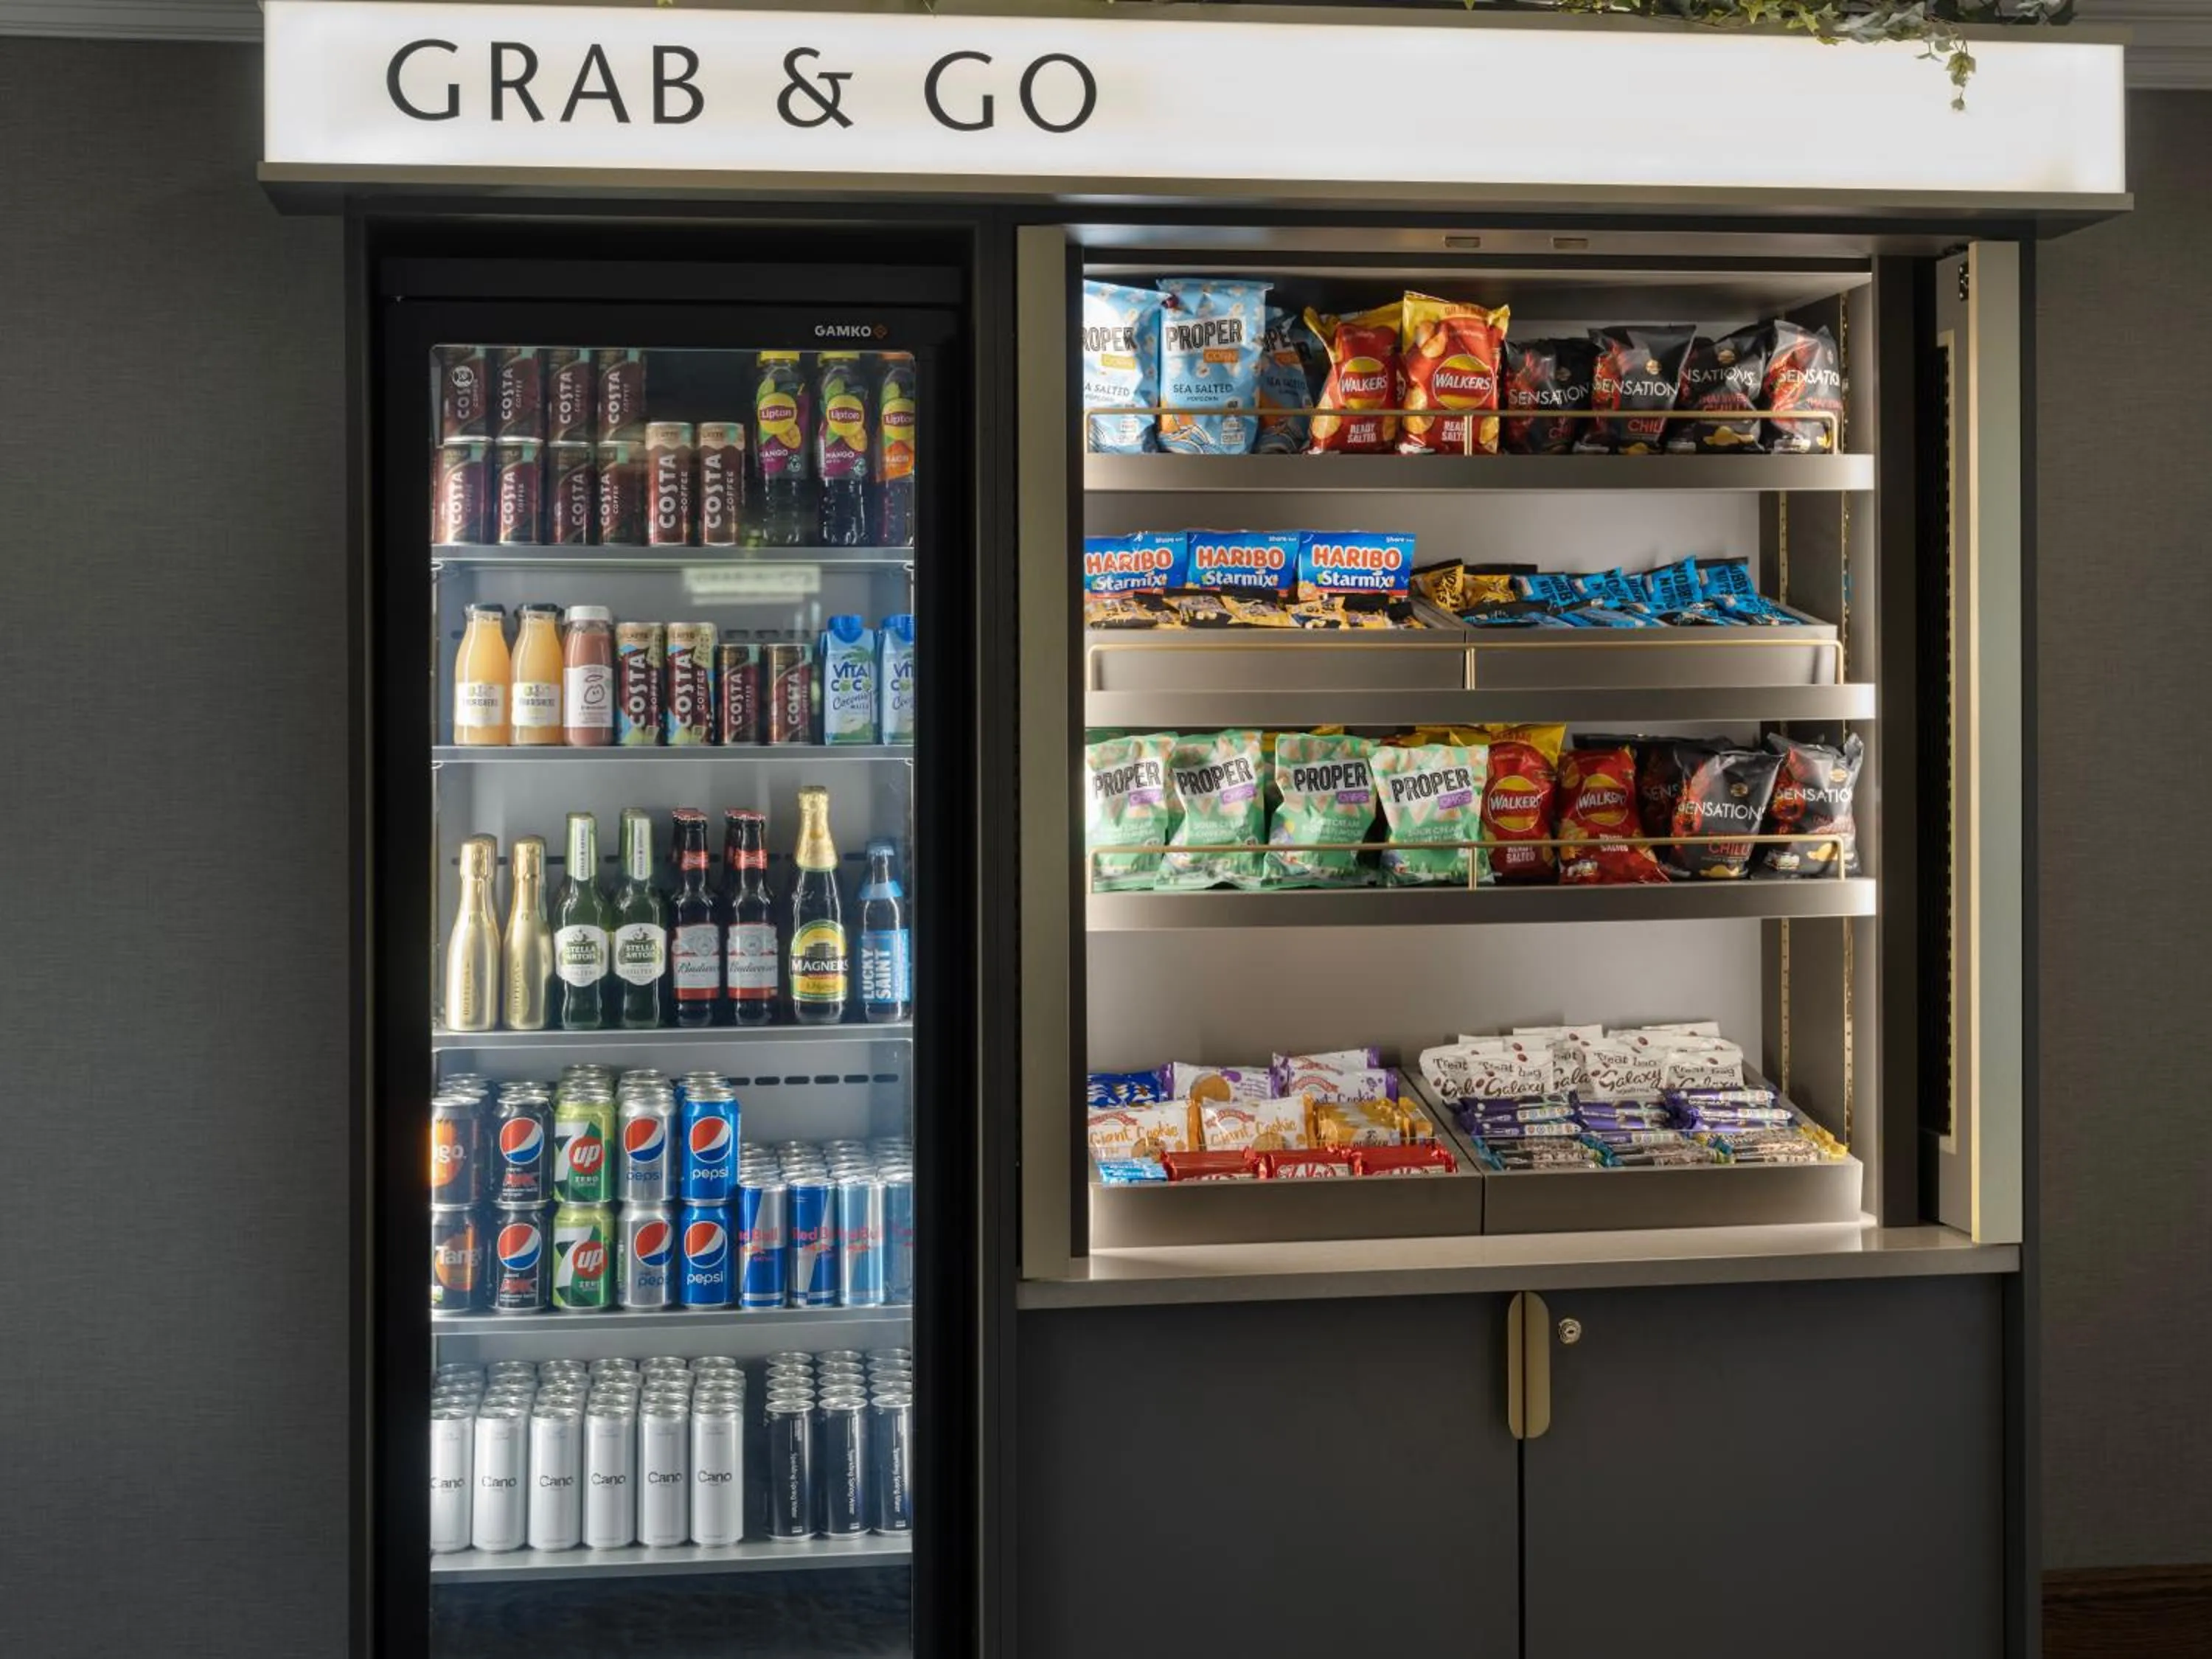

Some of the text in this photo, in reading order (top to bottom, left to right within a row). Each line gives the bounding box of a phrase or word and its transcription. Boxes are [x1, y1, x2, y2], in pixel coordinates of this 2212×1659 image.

[386, 38, 1098, 133] GRAB & GO
[814, 325, 872, 338] GAMKO
[1083, 326, 1136, 352] ROPER
[1165, 319, 1243, 352] PROPER
[1340, 374, 1388, 393] WALKERS
[1435, 372, 1493, 390] WALKERS
[1681, 366, 1756, 386] NSATIONS
[1778, 368, 1840, 387] SENSATIO
[1173, 383, 1234, 394] SEA SALTED
[1509, 383, 1590, 406] SENSATION
[1593, 377, 1679, 397] SENSATION
[559, 371, 574, 424] COSTA
[608, 371, 621, 424] COSTA
[761, 408, 793, 419] Lipton
[830, 410, 860, 420] Lipton
[1349, 423, 1376, 434] READY
[1444, 421, 1465, 431] REA
[1347, 433, 1377, 444] SALTED
[452, 471, 463, 524] COSTA
[502, 471, 515, 524] COSTA
[571, 473, 585, 526] COSTA
[599, 473, 611, 526] COSTA
[658, 453, 678, 529] COSTA
[705, 453, 724, 529] COSTA
[1085, 548, 1172, 575] HARIBO
[1196, 546, 1285, 569] HARIBO
[1312, 544, 1402, 570] HARIBO
[1096, 571, 1166, 591] Starmix
[1204, 568, 1277, 588] Starmix
[1321, 569, 1394, 589] Starmix
[832, 661, 868, 678] VITA
[893, 660, 913, 678] VIT
[628, 647, 647, 728] COSTA
[675, 652, 695, 728] COSTA
[729, 672, 742, 726] COSTA
[1093, 760, 1162, 798] PROPER
[1176, 757, 1253, 795] PROPER
[1293, 762, 1369, 792] PROPER
[1391, 768, 1472, 803] PROPER
[1773, 787, 1853, 804] SENSATIO
[1506, 852, 1537, 864] SALTED
[626, 944, 657, 952] STELLA
[791, 959, 849, 972] MAGNERS
[862, 947, 875, 1000] LUCKY
[875, 948, 892, 999] SAINT
[1433, 1057, 1468, 1071] Treat
[1484, 1077, 1545, 1097] Galaxy
[1599, 1068, 1663, 1092] Galaxy
[692, 1166, 729, 1181] pepsi
[686, 1270, 724, 1285] pepsi
[481, 1475, 518, 1488] Cano
[539, 1475, 574, 1487] Cano
[591, 1472, 627, 1485] Cano
[648, 1471, 684, 1484] Cano
[698, 1470, 732, 1484] Cano
